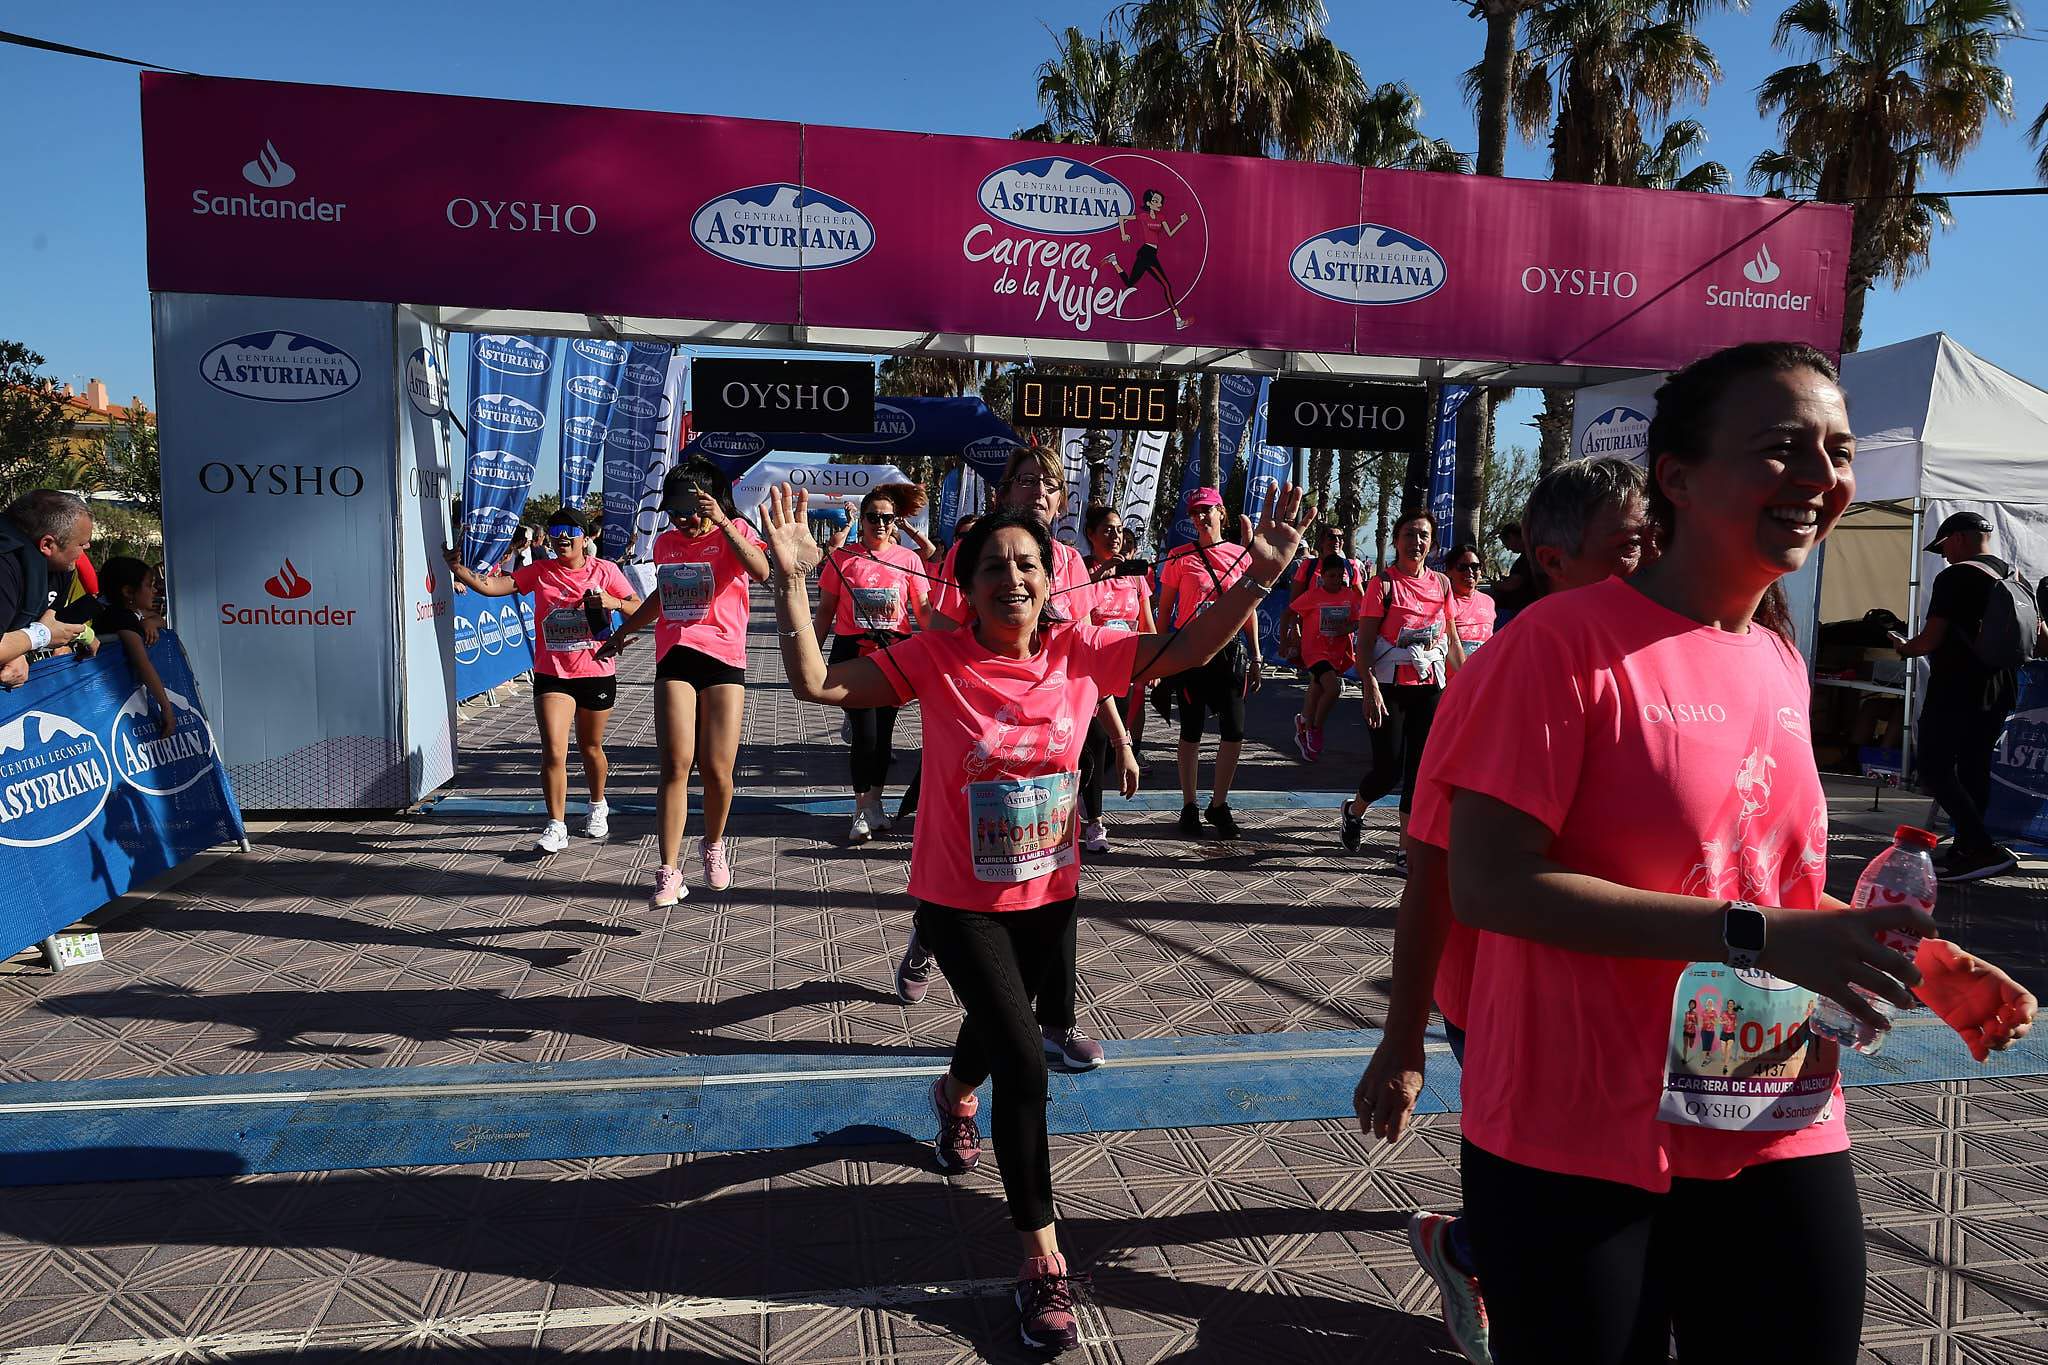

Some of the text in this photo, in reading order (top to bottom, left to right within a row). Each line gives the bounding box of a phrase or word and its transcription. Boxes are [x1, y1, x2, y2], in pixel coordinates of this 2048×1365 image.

[989, 181, 1121, 218] ASTURIANA
[1014, 181, 1119, 196] CENTRAL LECHERA
[192, 189, 346, 222] Santander
[446, 196, 597, 235] OYSHO
[734, 211, 792, 222] CENTRAL
[705, 211, 861, 251] ASTURIANA
[962, 223, 1092, 271] Carrera
[1326, 250, 1431, 264] CENTRAL LECHERA
[1301, 249, 1434, 287] ASTURIANA
[1521, 266, 1638, 299] OYSHO
[993, 267, 1138, 332] de la Mujer
[1706, 285, 1812, 312] Santander
[236, 354, 344, 366] CENTRAL LECHERA
[478, 342, 545, 370] ASTURIANA
[577, 340, 625, 362] ASTURIANA
[212, 354, 350, 386] ASTURIANA
[722, 381, 850, 412] OYSHO
[1024, 383, 1165, 422] 01:05:06
[474, 402, 539, 428] ASTURIANA
[1294, 401, 1405, 432] OYSHO
[608, 432, 647, 449] ASTURIANA
[703, 436, 760, 451] ASTURIANA
[1584, 431, 1648, 454] ASTURIANA
[969, 447, 1010, 458] ASTURIA
[199, 462, 364, 497] OYSHO
[409, 467, 447, 500] OYSHO
[789, 468, 870, 487] OYSHO
[220, 604, 356, 626] Santander
[1643, 703, 1726, 723] OYSHO
[0, 754, 47, 778] CENTRAL
[1009, 821, 1049, 842] 016
[1020, 842, 1039, 853] 1789
[986, 867, 1022, 877] OYSHO
[1753, 1063, 1786, 1077] 4137
[1676, 1077, 1729, 1093] CARRERA
[1732, 1081, 1746, 1093] DE
[1749, 1081, 1762, 1094] LA
[1764, 1081, 1794, 1094] MUJER
[1685, 1101, 1751, 1120] OYSHO
